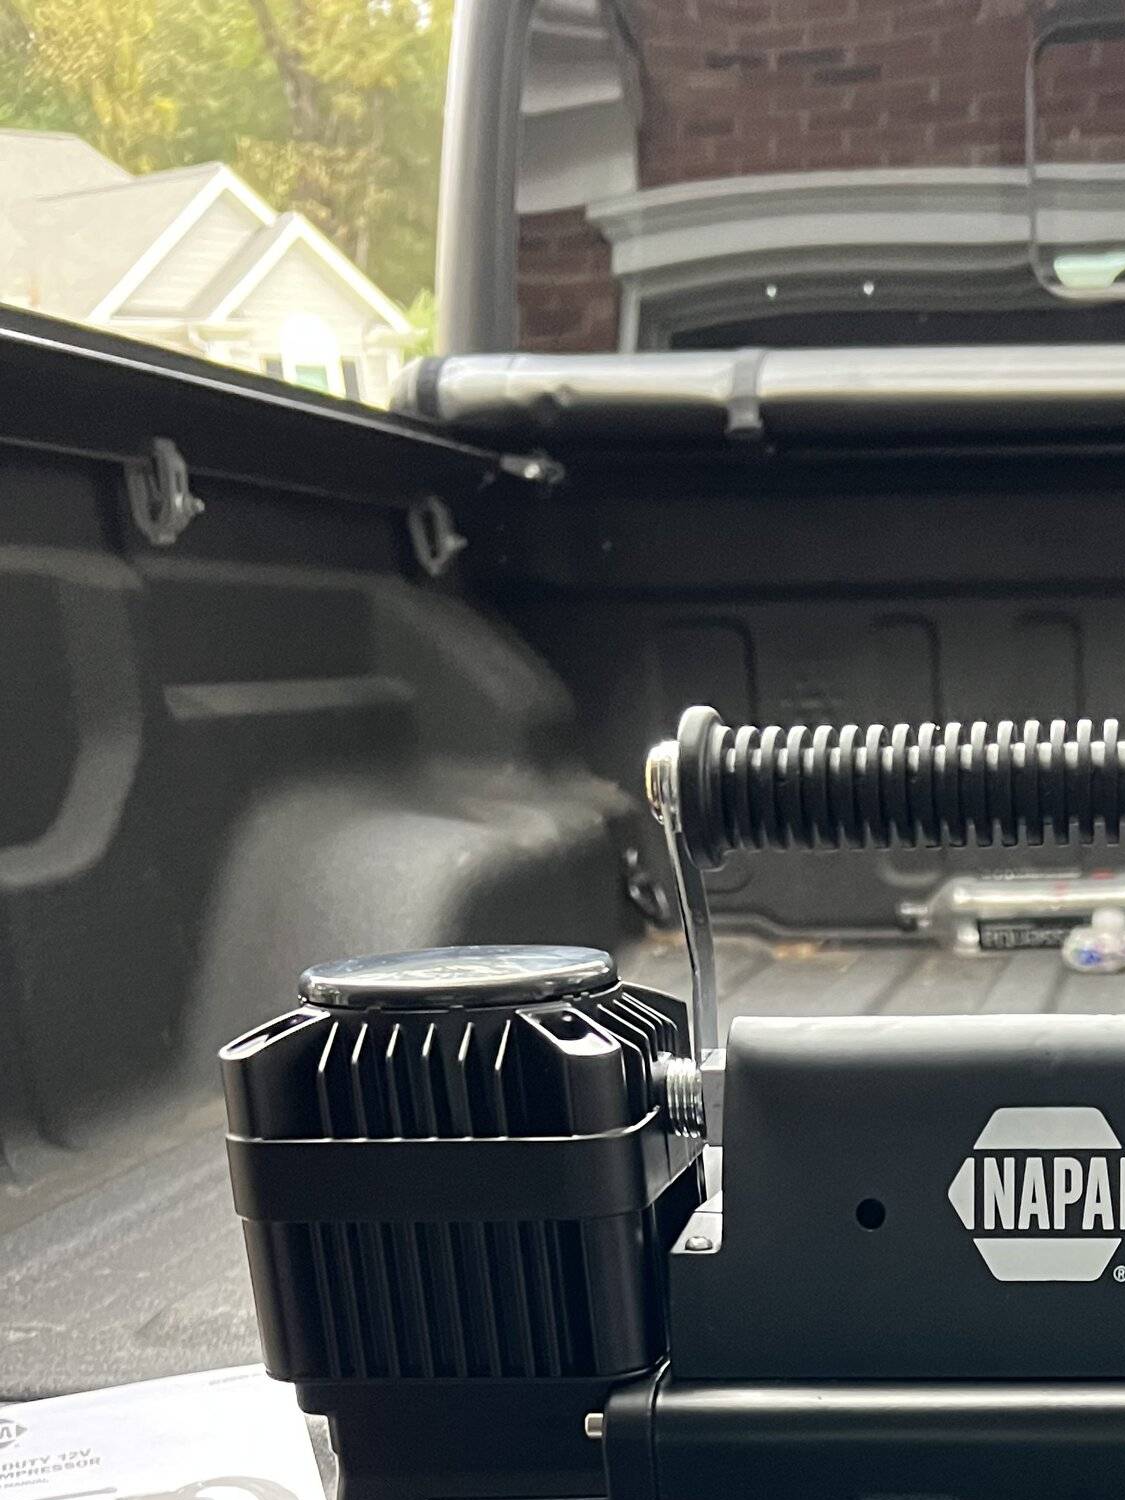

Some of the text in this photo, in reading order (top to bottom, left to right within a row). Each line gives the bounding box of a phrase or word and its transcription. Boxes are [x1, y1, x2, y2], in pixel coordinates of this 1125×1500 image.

[983, 1157, 1115, 1230] NAPA
[58, 1449, 91, 1461] 12V
[0, 1457, 101, 1479] MPRESSOR
